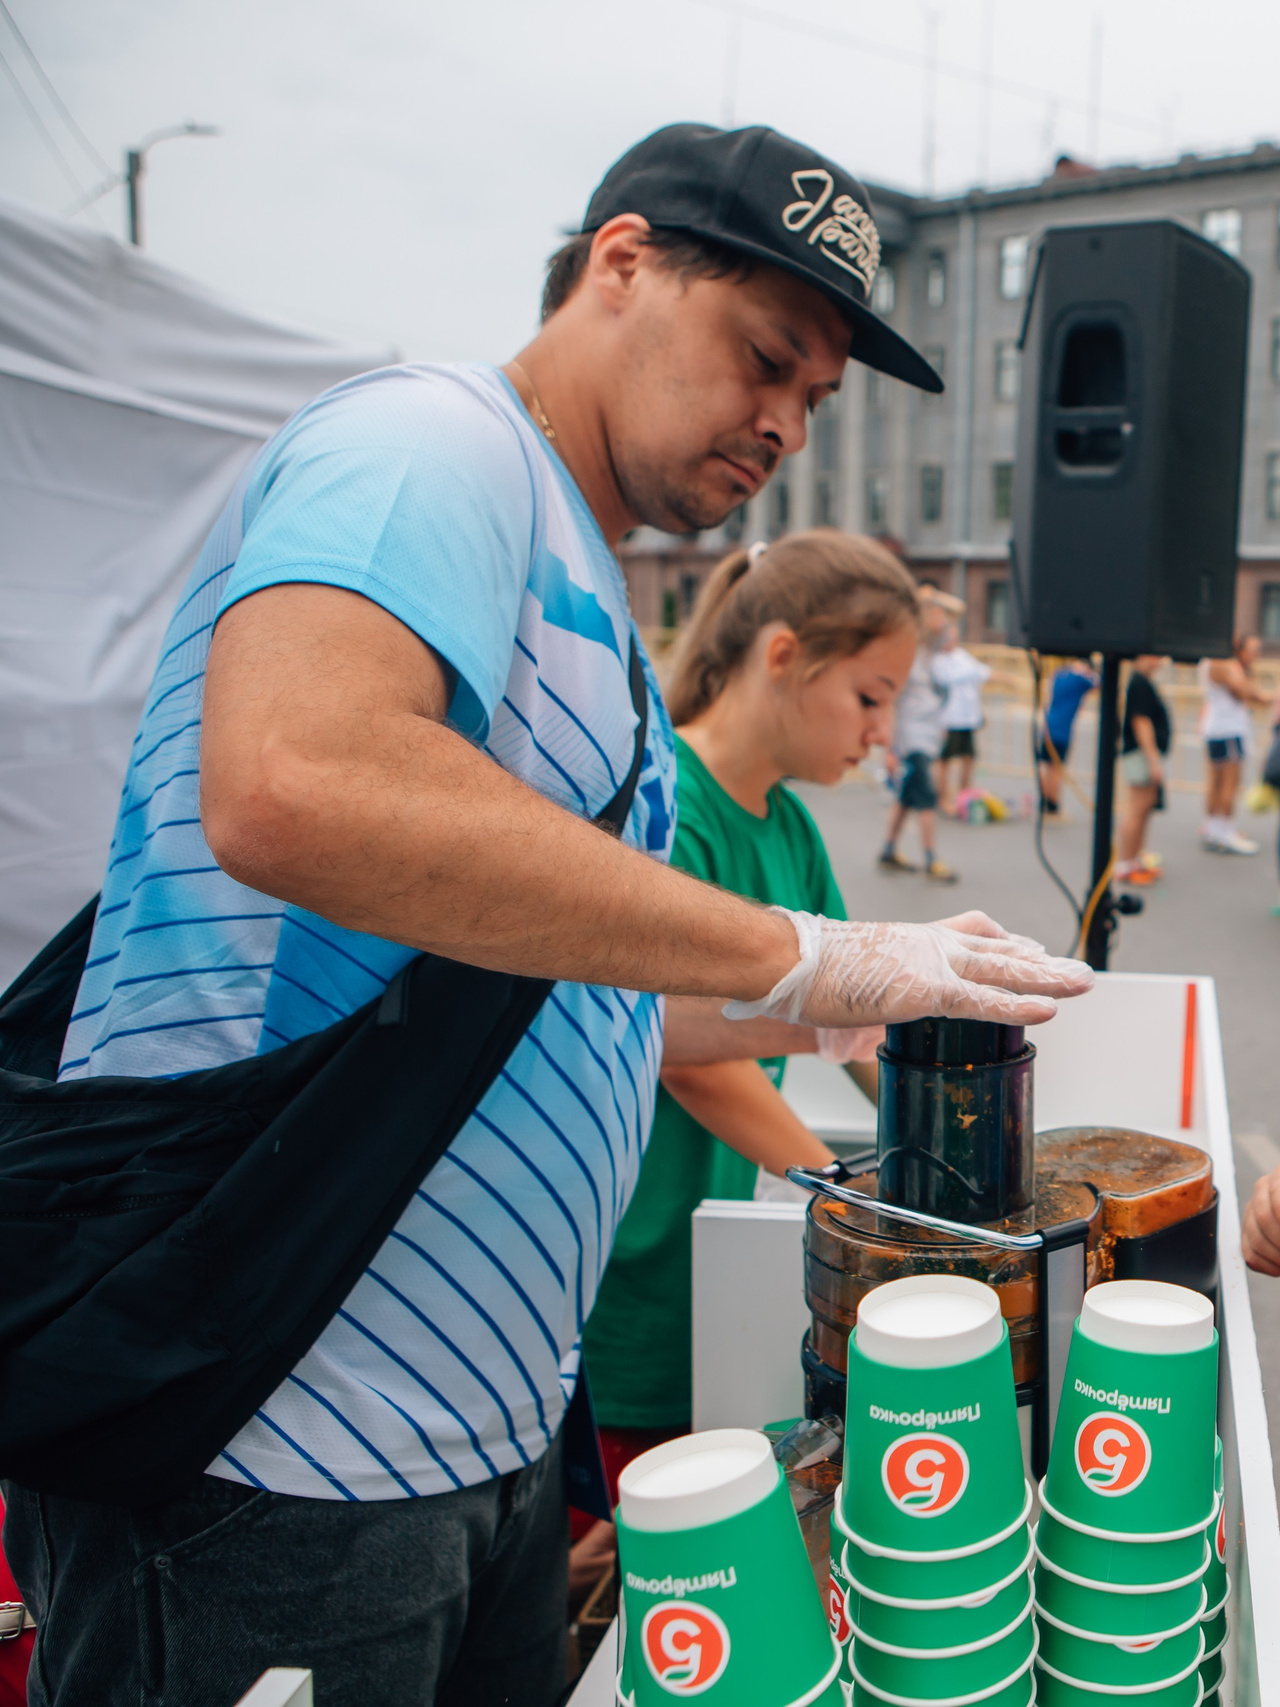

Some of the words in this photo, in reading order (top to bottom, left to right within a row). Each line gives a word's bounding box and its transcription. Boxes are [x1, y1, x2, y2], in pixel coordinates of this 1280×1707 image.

[1074, 1378, 1171, 1415] Пятёрочка
[869, 1402, 981, 1430] Пятёрочка
[625, 1565, 738, 1598] Пятёрочка
